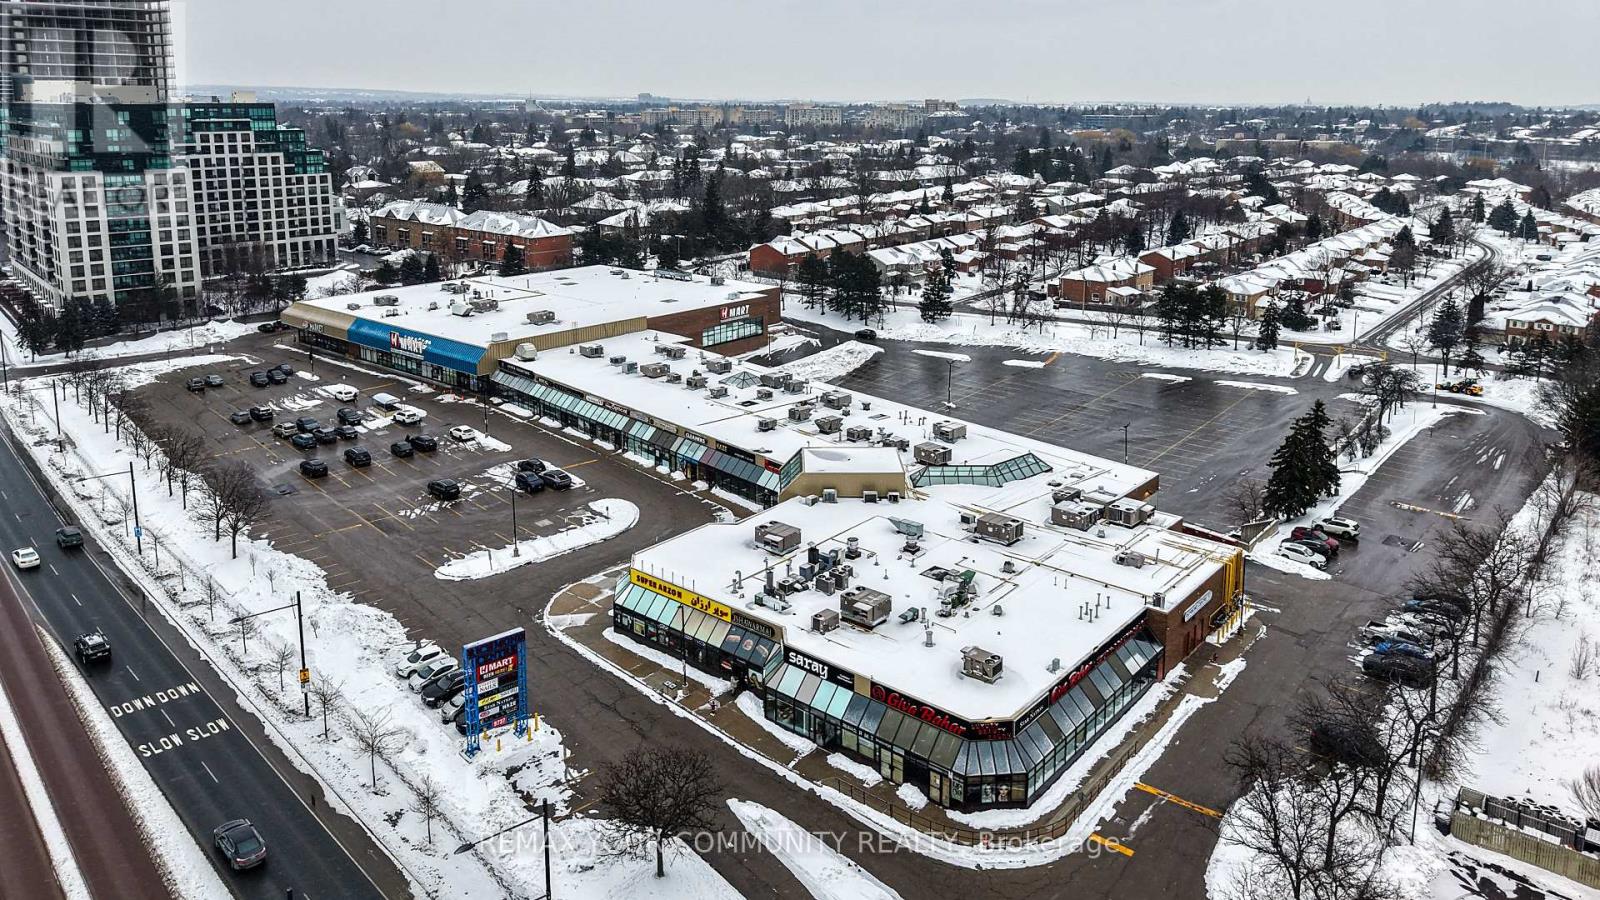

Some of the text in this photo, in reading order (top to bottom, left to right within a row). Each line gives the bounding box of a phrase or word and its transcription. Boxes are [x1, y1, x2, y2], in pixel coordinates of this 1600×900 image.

[729, 305, 750, 317] MART
[636, 574, 682, 599] SUPER ARZON
[489, 656, 514, 671] MART
[788, 651, 829, 679] saray
[110, 681, 200, 718] DOWN DOWN
[138, 717, 230, 757] SLOW SLOW
